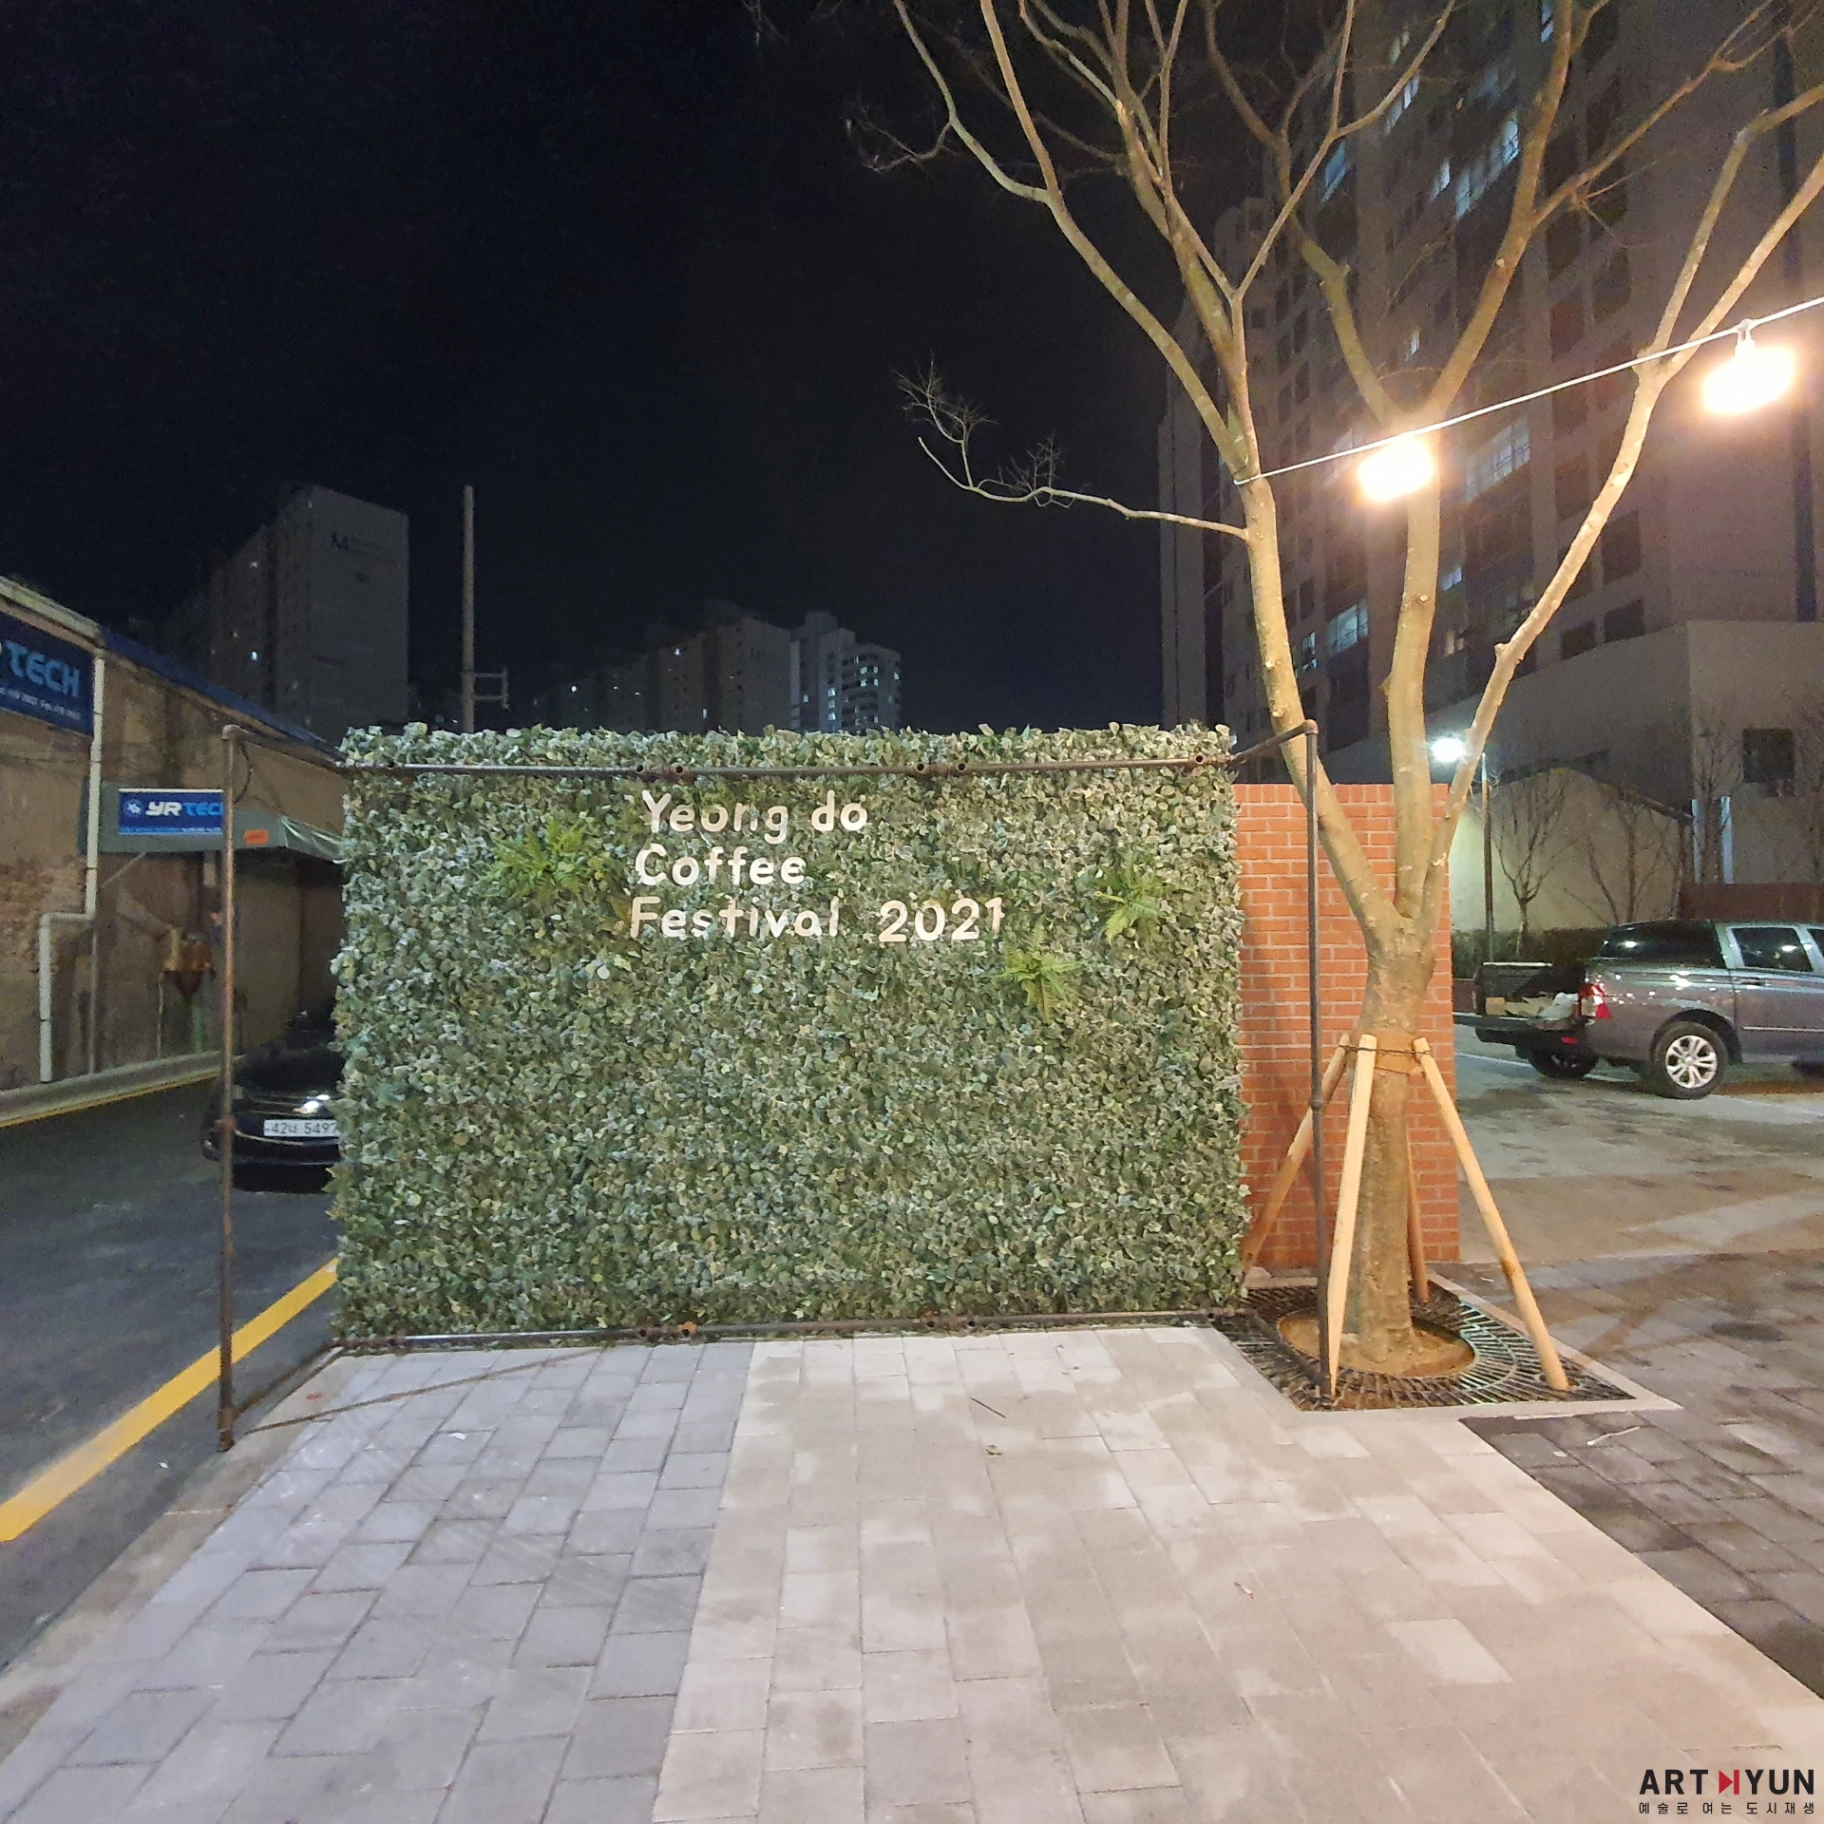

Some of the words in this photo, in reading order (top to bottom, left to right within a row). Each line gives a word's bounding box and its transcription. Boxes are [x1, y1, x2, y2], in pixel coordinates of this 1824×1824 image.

[4, 640, 81, 698] TECH
[641, 789, 788, 845] Yeong
[811, 790, 868, 832] do
[635, 843, 807, 886] Coffee
[630, 896, 839, 939] Festival
[879, 897, 1003, 943] 2021
